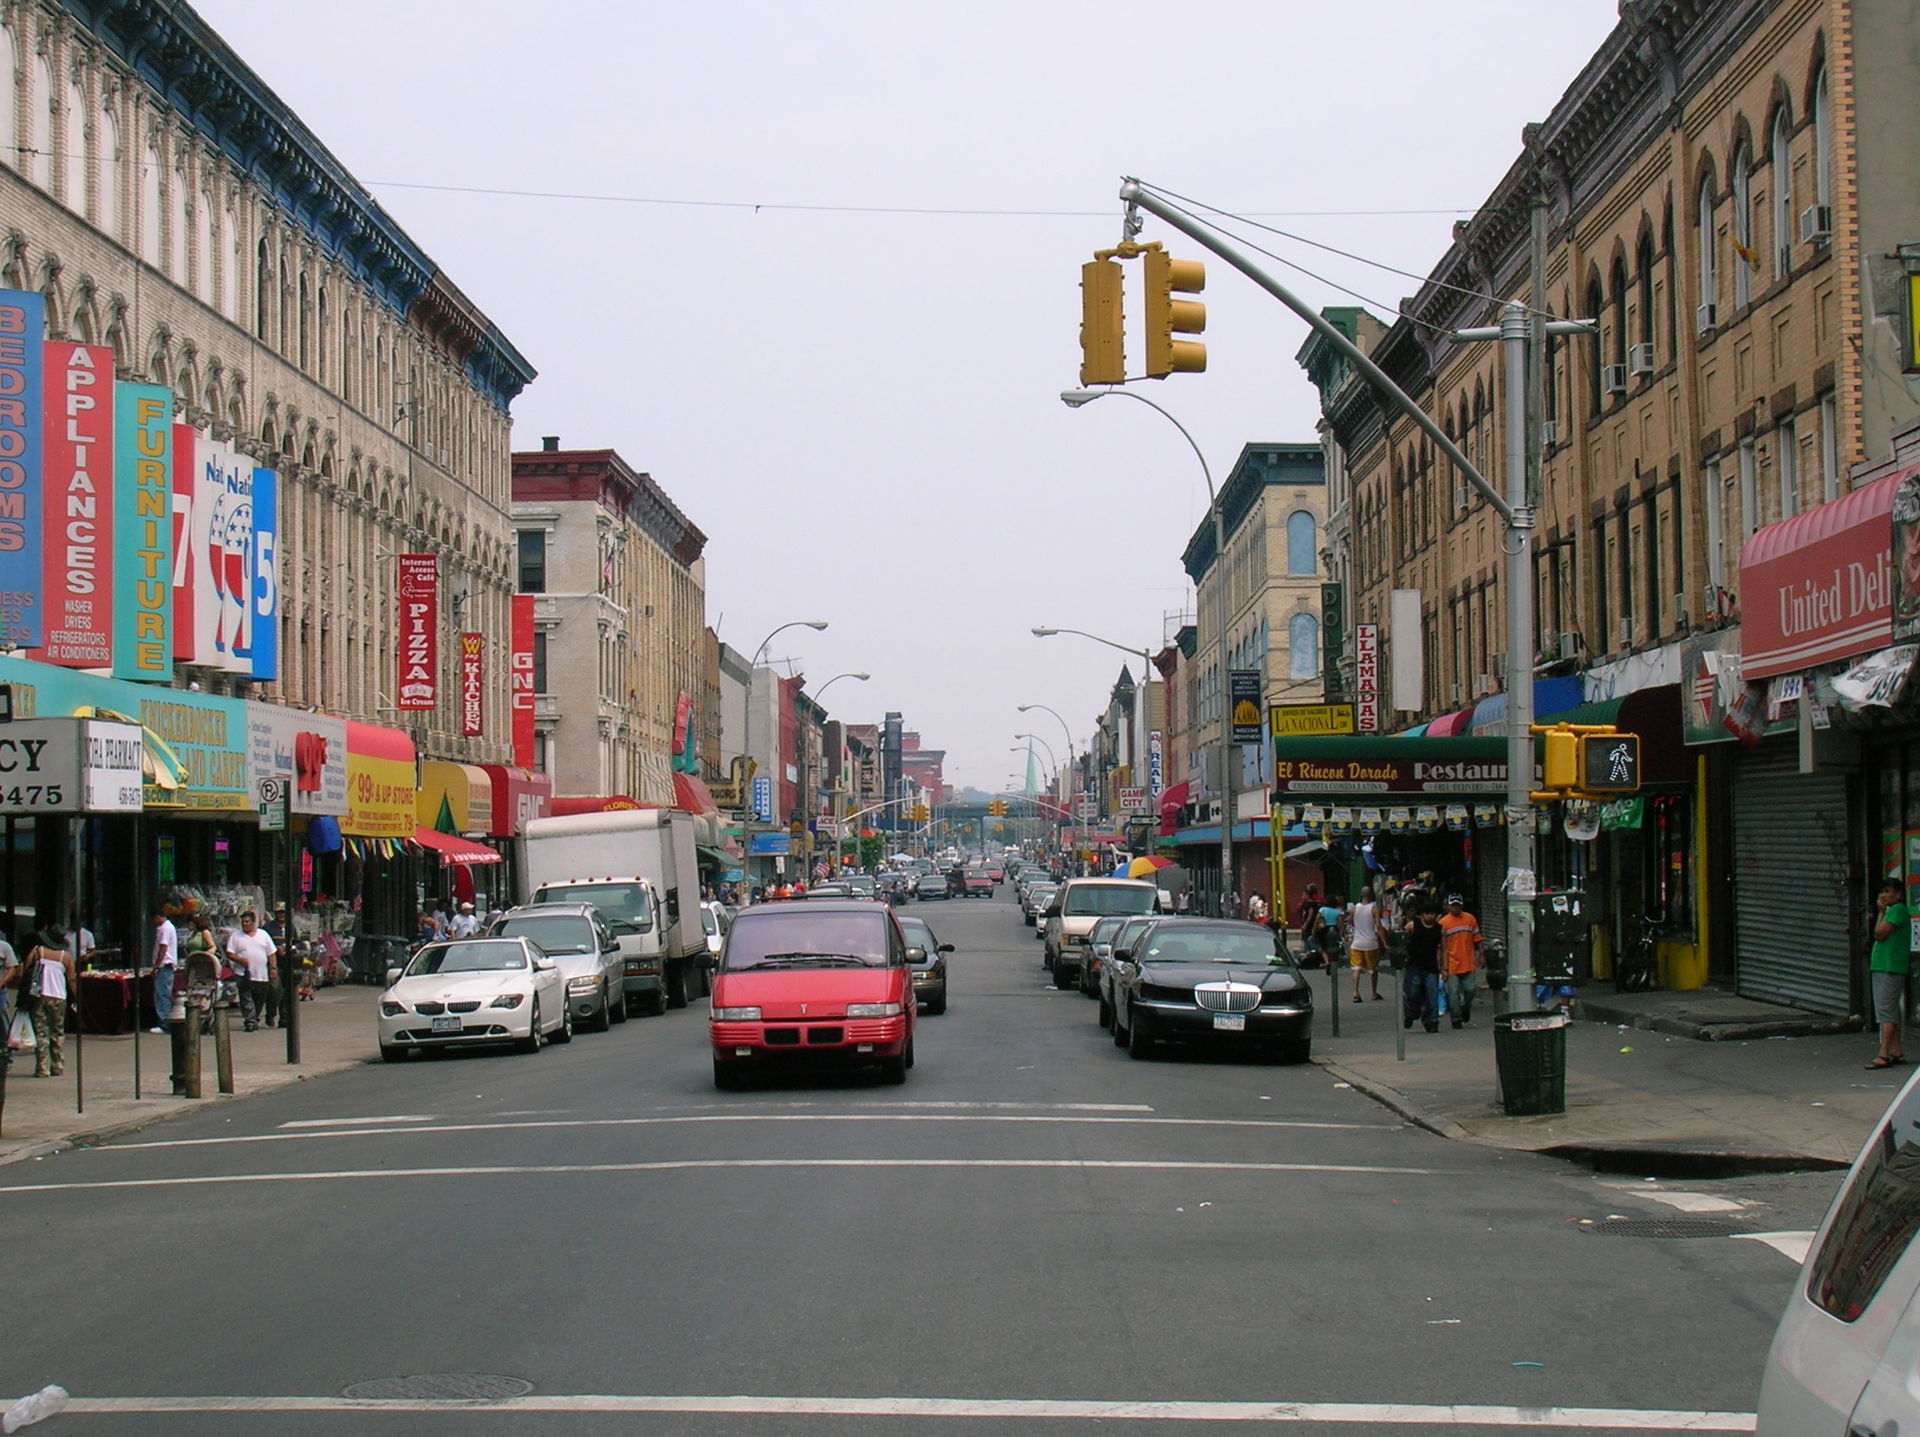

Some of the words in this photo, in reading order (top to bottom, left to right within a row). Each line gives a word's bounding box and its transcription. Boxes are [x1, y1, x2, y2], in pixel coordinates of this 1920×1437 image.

[66, 346, 97, 595] APPLIANCES
[136, 397, 165, 671] FURNITURE
[401, 558, 435, 567] Internet
[409, 566, 435, 574] Access
[1778, 568, 1842, 638] United
[1847, 549, 1892, 619] Deli
[64, 599, 93, 614] WASHER
[64, 615, 92, 630] DRYERS
[50, 630, 106, 646] REFRIGERATORS
[405, 603, 430, 680] PIZZA
[61, 646, 110, 661] CONDITIONERS
[512, 652, 533, 710] GNC
[1359, 626, 1375, 730] LLAMADAS
[400, 698, 411, 706] Ice
[412, 698, 434, 706] Cream
[464, 662, 480, 732] KITCHEN
[1291, 706, 1338, 731] NACIONAL
[1278, 761, 1293, 779] El
[1299, 762, 1344, 780] Rincon
[1348, 762, 1399, 780] Dorado
[1120, 789, 1145, 798] GAME
[1122, 798, 1143, 807] CITY
[517, 792, 544, 823] GNC
